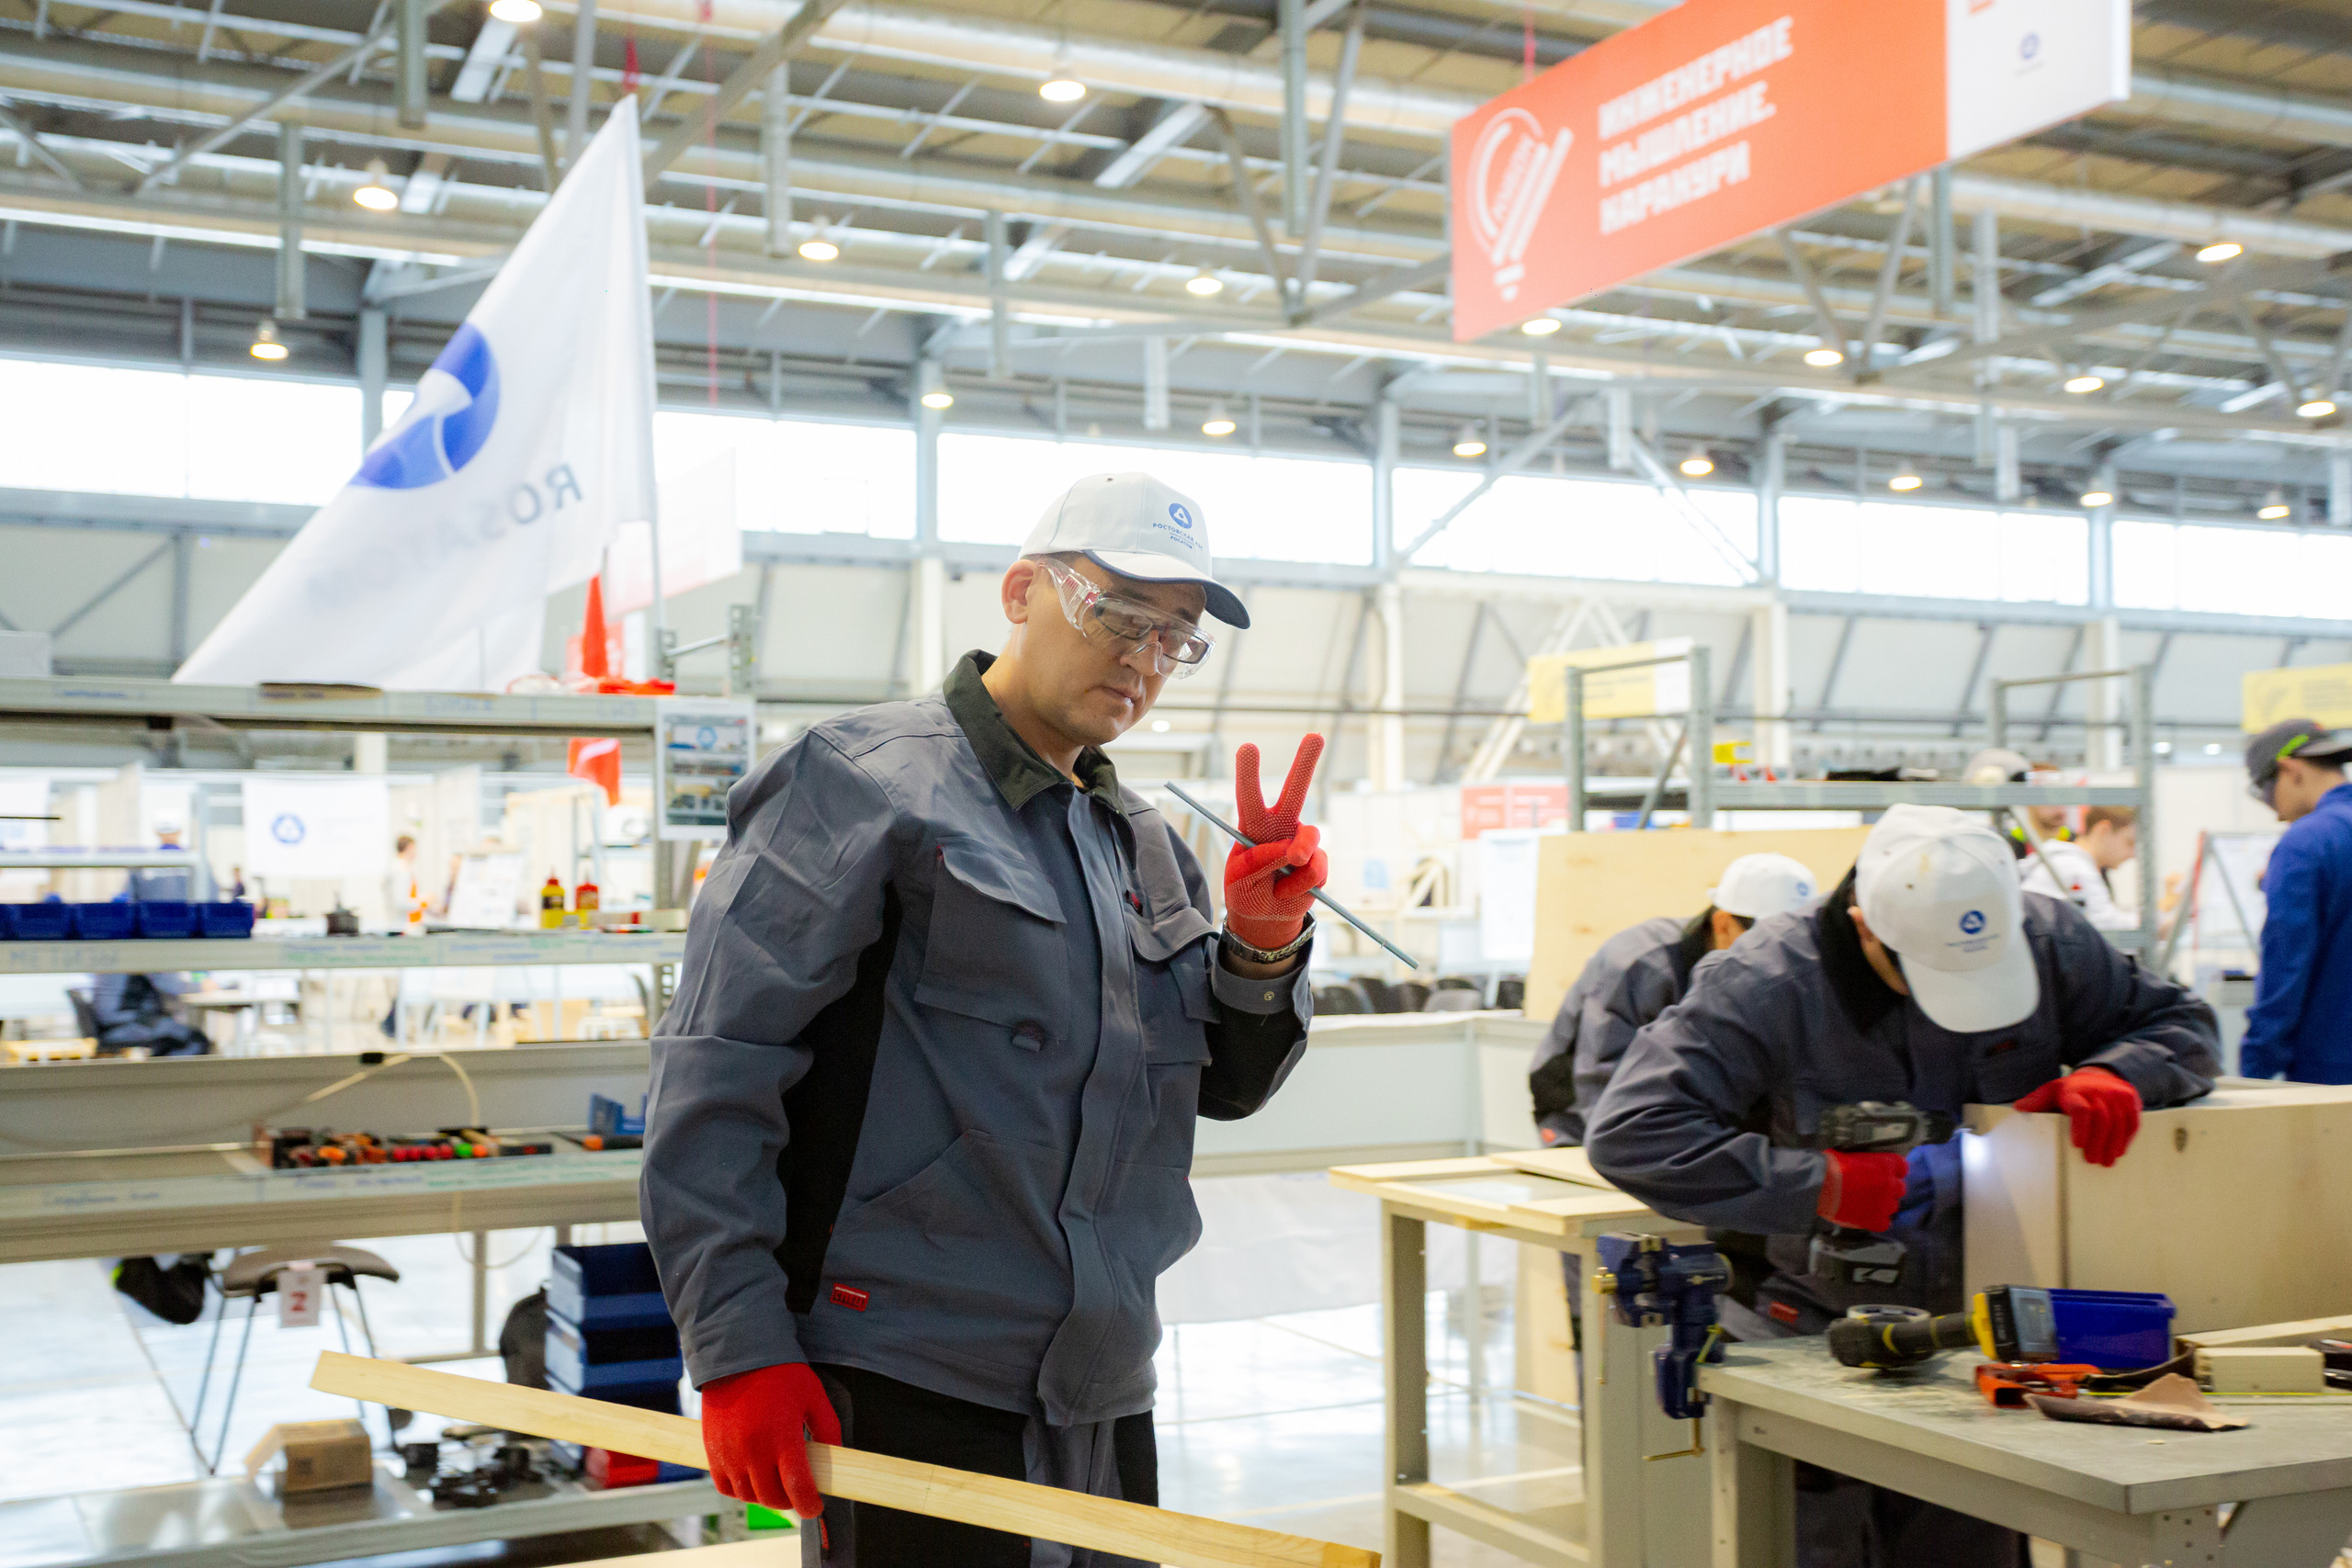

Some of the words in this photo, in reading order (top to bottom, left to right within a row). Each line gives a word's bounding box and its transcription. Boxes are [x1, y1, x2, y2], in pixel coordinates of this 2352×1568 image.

[1598, 15, 1793, 141] ИНЖЕНЕРНОЕ
[1599, 80, 1778, 187] МЫШЛЕНИЕ.
[1599, 140, 1750, 235] КАРАКУРИ
[1152, 522, 1194, 542] РОСТОВСКАЯ
[1170, 535, 1193, 550] РОСАТОМ
